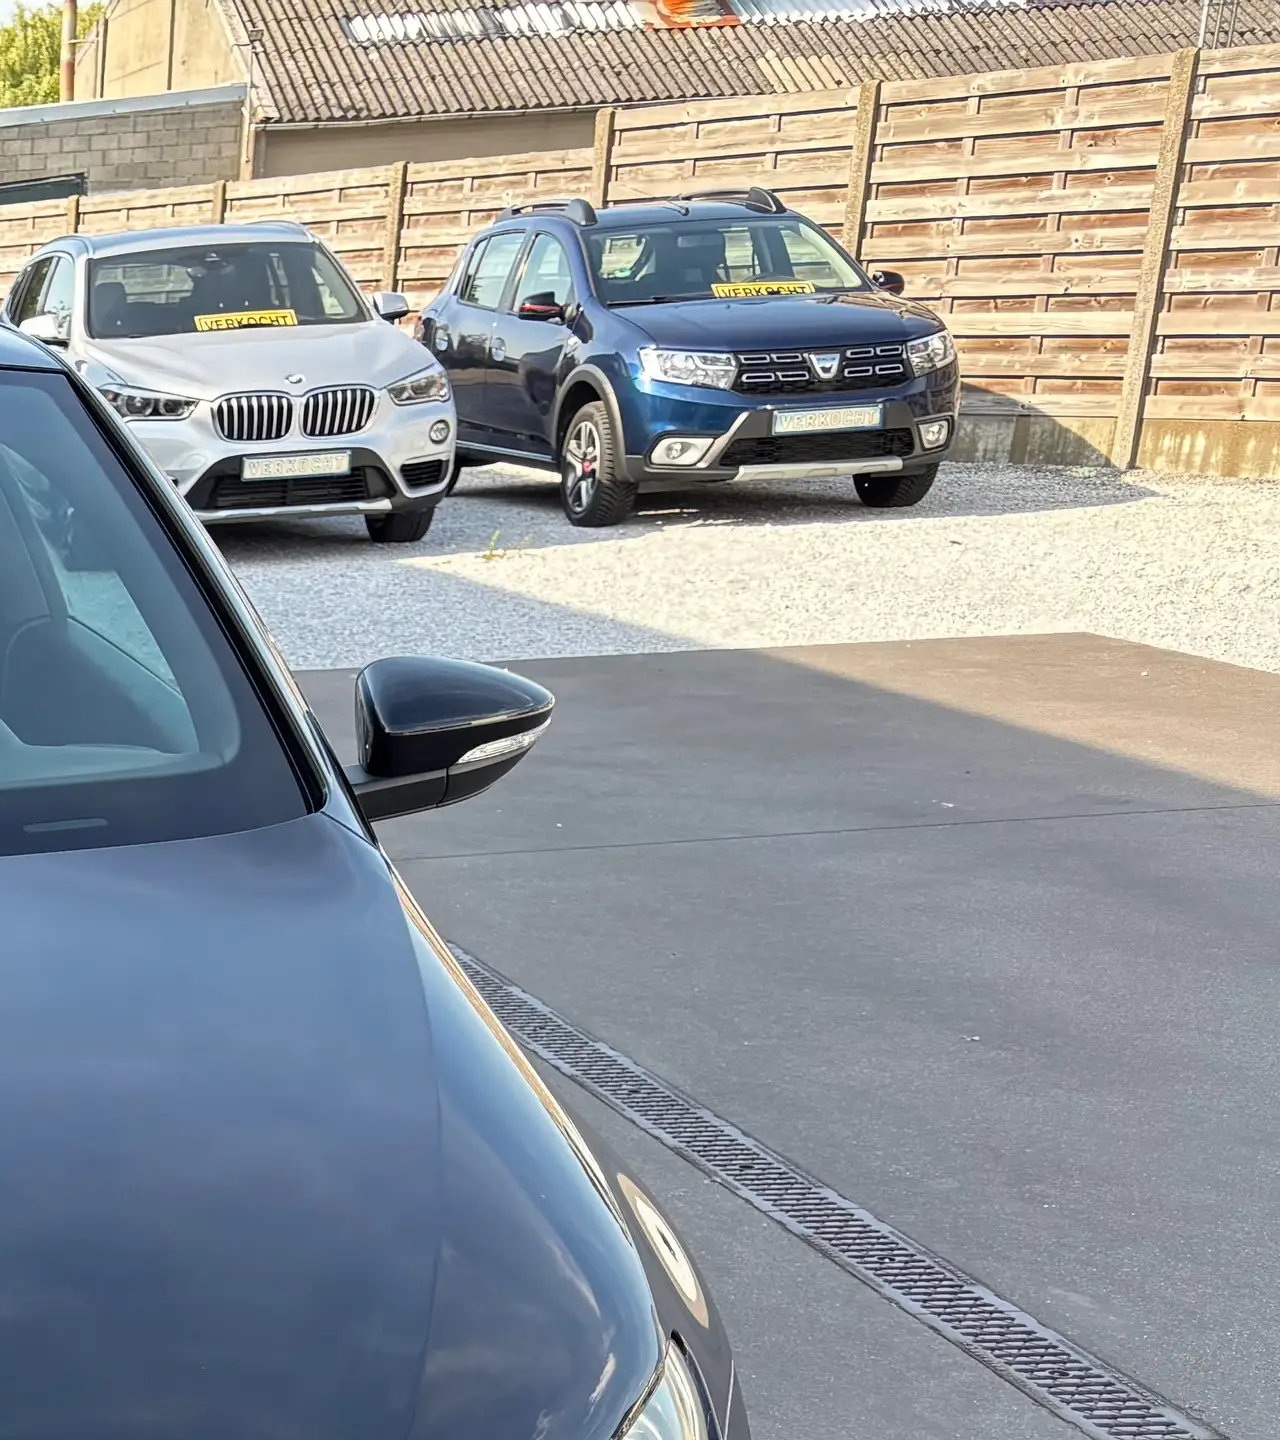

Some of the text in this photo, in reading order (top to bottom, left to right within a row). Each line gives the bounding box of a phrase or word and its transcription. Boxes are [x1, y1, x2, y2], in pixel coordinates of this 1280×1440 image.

[721, 286, 807, 298] VERKOCHT
[204, 315, 289, 330] VERKOCHT
[781, 409, 877, 430] VERKOCHT
